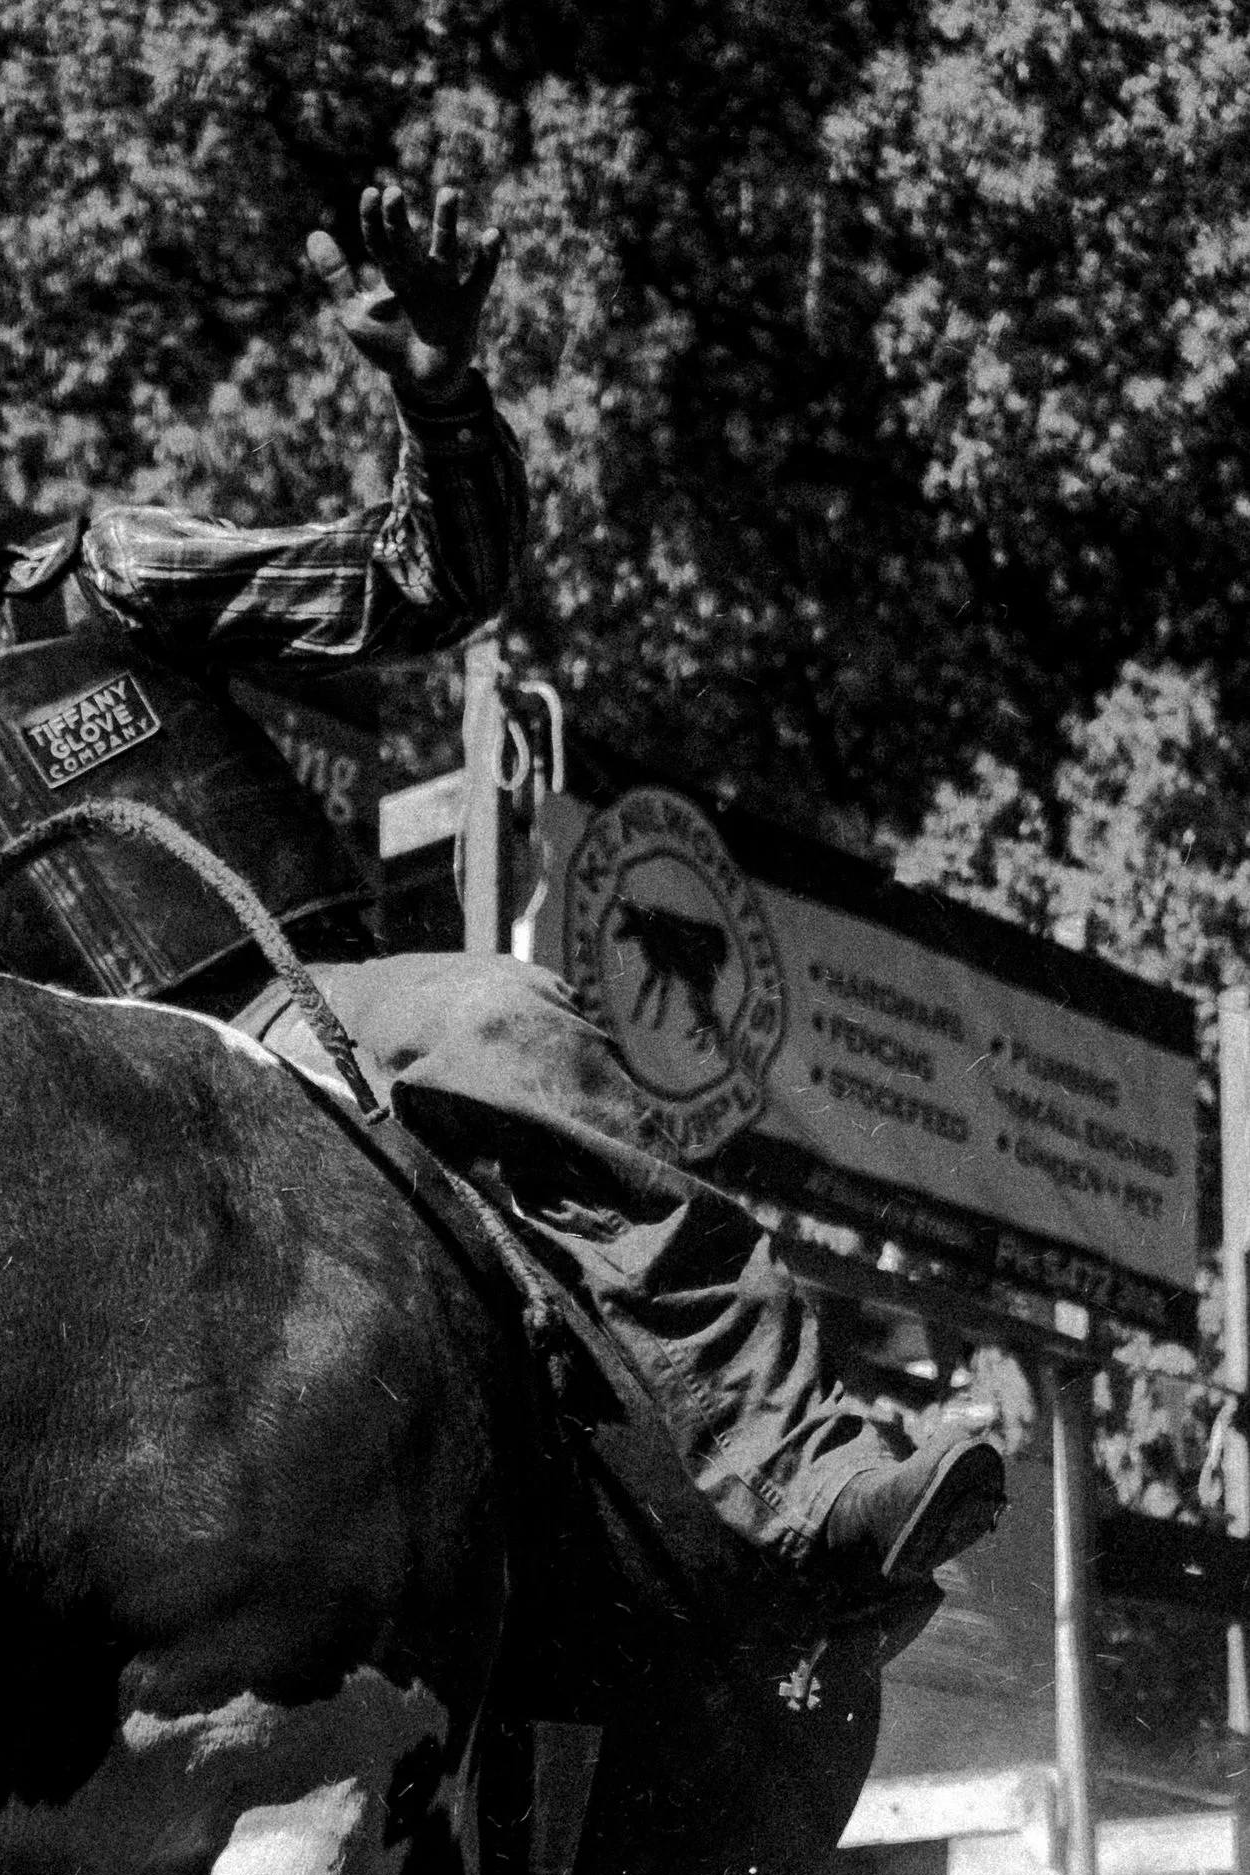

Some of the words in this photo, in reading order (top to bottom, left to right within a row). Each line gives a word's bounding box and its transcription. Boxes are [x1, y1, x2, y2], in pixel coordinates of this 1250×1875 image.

[28, 680, 127, 747] TIFFANY
[50, 704, 134, 759] GLOVE
[49, 718, 148, 779] COMPANY
